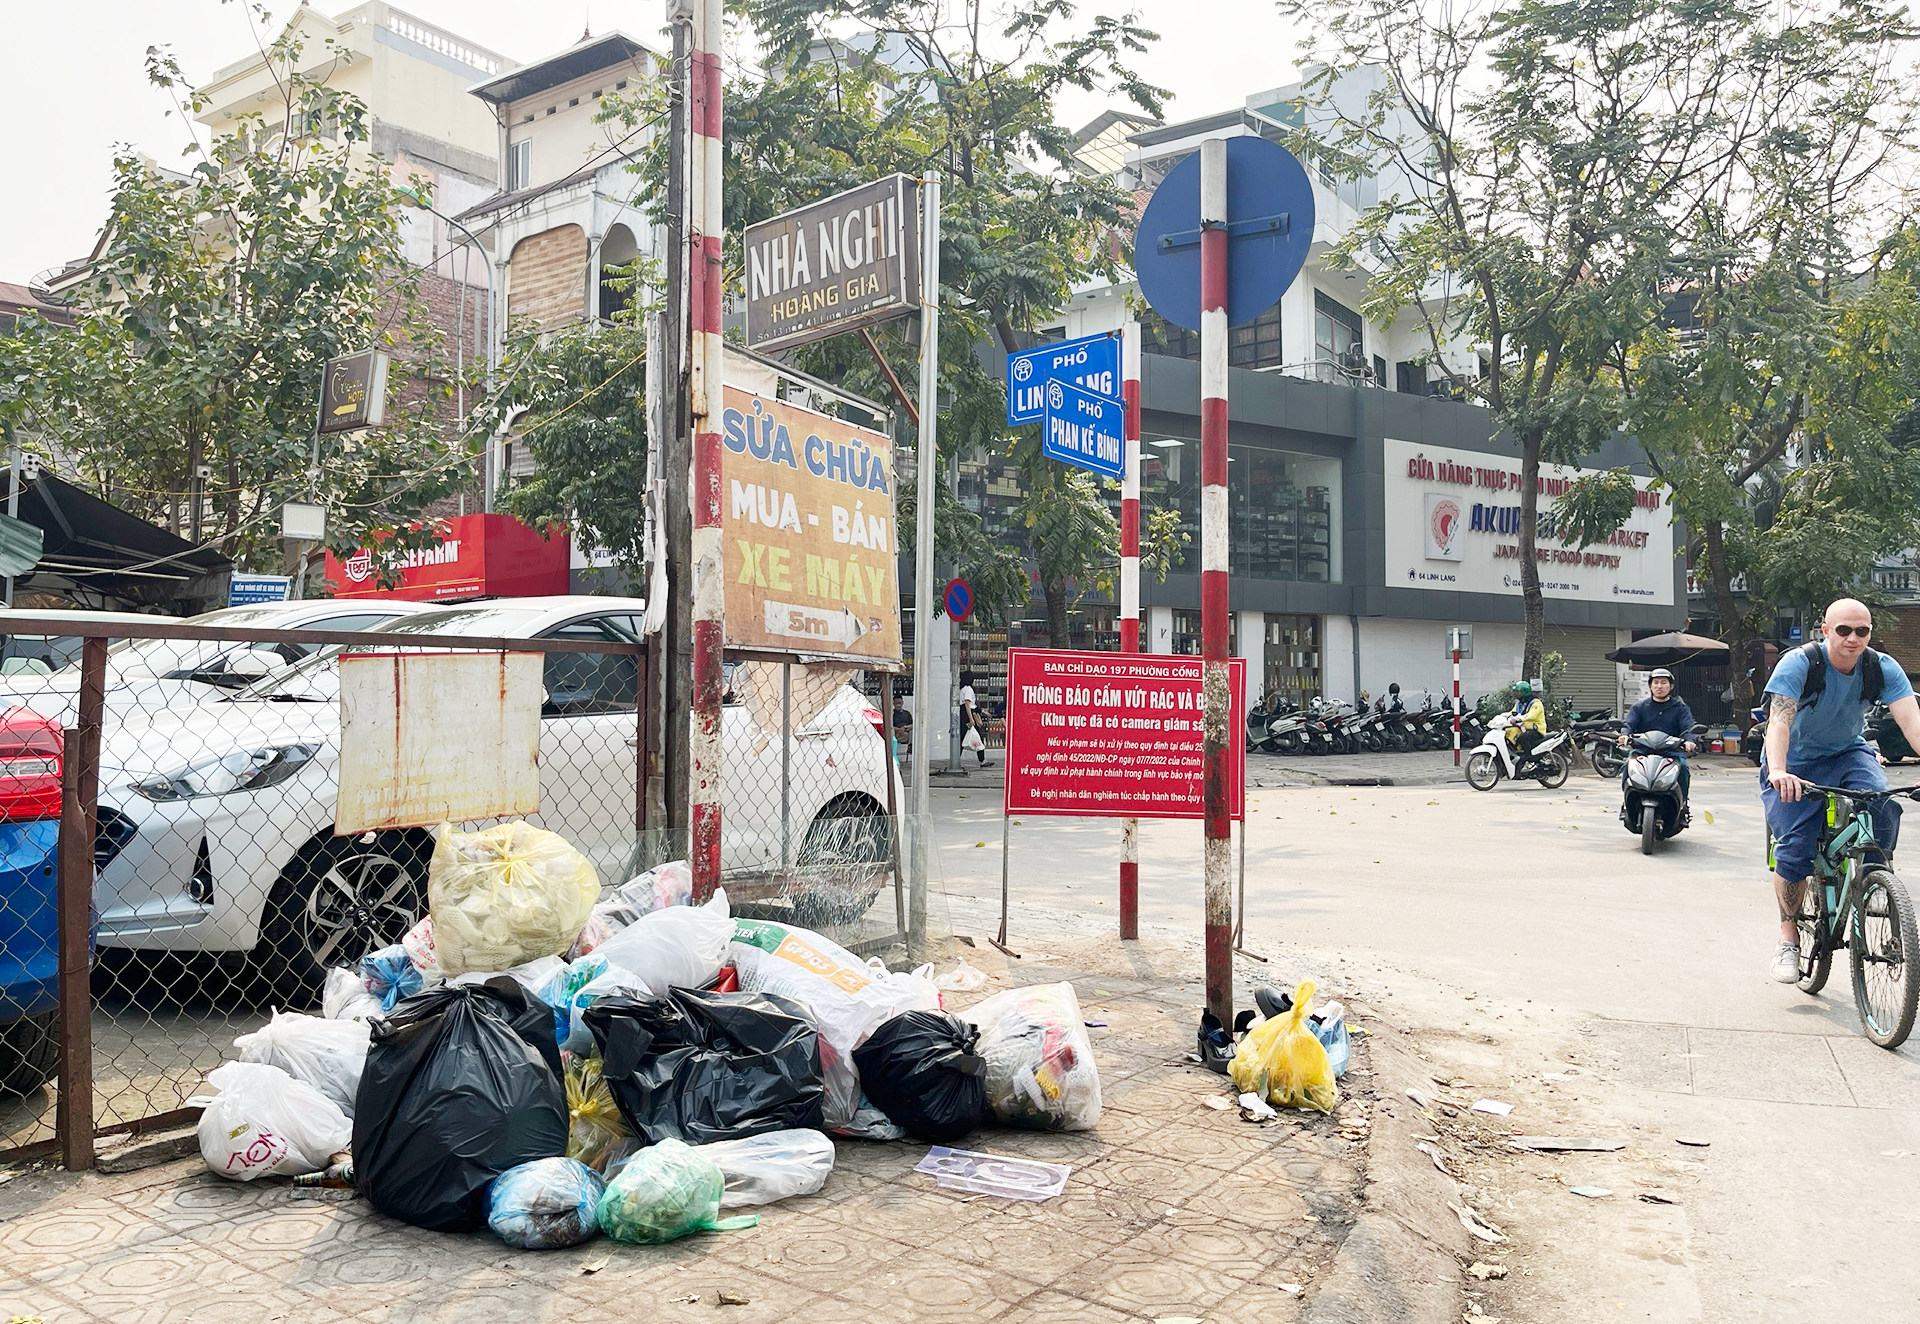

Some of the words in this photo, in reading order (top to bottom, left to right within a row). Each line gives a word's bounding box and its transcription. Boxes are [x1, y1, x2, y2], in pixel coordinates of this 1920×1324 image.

[750, 221, 812, 302] NHÀ
[818, 184, 897, 279] NGHỈ
[771, 284, 839, 323] HOÀNG
[846, 273, 880, 301] GIA
[1053, 344, 1090, 370] PHỐ
[1017, 385, 1044, 412] LIN
[1078, 401, 1103, 419] PHỐ
[723, 399, 798, 470] SỬA
[804, 435, 890, 496] CHỮA
[1051, 417, 1078, 451] PHAN
[1082, 423, 1095, 455] KẾ
[1097, 429, 1119, 464] BÍNH
[1408, 453, 1435, 481] CỬA
[1474, 467, 1507, 493] THỰC
[730, 478, 803, 534] MUA
[831, 499, 888, 553] BÁN
[1551, 549, 1582, 565] FOOD
[1583, 552, 1622, 569] SUPPLY
[736, 539, 792, 593] XE
[806, 554, 886, 607] MÁY
[1418, 572, 1426, 580] 64
[1427, 573, 1439, 581] LINH
[1440, 574, 1456, 582] LANG
[788, 611, 829, 636] 5m
[1044, 662, 1065, 672] BAN
[1067, 661, 1083, 673] CHỈ
[1085, 664, 1107, 675] ĐẠO
[1110, 666, 1126, 675] 197
[1129, 665, 1169, 677] PHƯỜNG
[1172, 664, 1199, 677] CỐNG
[1022, 683, 1062, 705] THÔNG
[1066, 684, 1090, 706] BÁO
[1093, 683, 1121, 707] CẤM
[1124, 685, 1147, 708] VỨT
[1150, 688, 1174, 709] RÁC
[1177, 689, 1193, 710] VÀ
[1041, 712, 1065, 727] (Khu
[1068, 714, 1087, 729] vực
[1090, 713, 1103, 728] đã
[1106, 715, 1119, 728] có
[1121, 718, 1161, 730] camera
[1164, 717, 1189, 732] giám
[1047, 736, 1061, 747] Nếu
[1062, 738, 1069, 747] vi
[1069, 738, 1088, 749] phạm
[1089, 739, 1098, 748] sẽ
[1099, 739, 1106, 749] bị
[1107, 738, 1116, 748] xử
[1116, 739, 1123, 751] lý
[1124, 740, 1139, 749] theo
[1140, 742, 1152, 752] quy
[1153, 740, 1169, 752] định
[1169, 742, 1179, 752] tại
[1179, 741, 1194, 751] điều
[1036, 752, 1052, 763] nghị
[1052, 752, 1068, 763] định
[1069, 753, 1118, 764] 45/2022/NĐ-CP
[1118, 755, 1135, 766] ngày
[1136, 755, 1167, 765] 07/7/2022
[1167, 755, 1180, 765] của
[1181, 756, 1201, 766] Chính
[1029, 766, 1043, 777] quy
[1043, 766, 1059, 776] định
[1060, 766, 1069, 775] xử
[1069, 767, 1085, 777] phạt
[1085, 767, 1103, 776] hành
[1104, 768, 1123, 778] chính
[1124, 769, 1142, 780] trong
[1143, 769, 1156, 778] lĩnh
[1157, 771, 1169, 780] vực
[1170, 769, 1182, 779] bảo
[1184, 770, 1192, 780] vệ
[1042, 789, 1058, 800] nghị
[1059, 789, 1077, 799] nhân
[1078, 789, 1092, 799] dân
[1093, 790, 1119, 801] nghiêm
[1120, 791, 1132, 800] túc
[1151, 792, 1169, 801] hành
[1170, 792, 1186, 802] theo
[1187, 795, 1200, 804] quy
